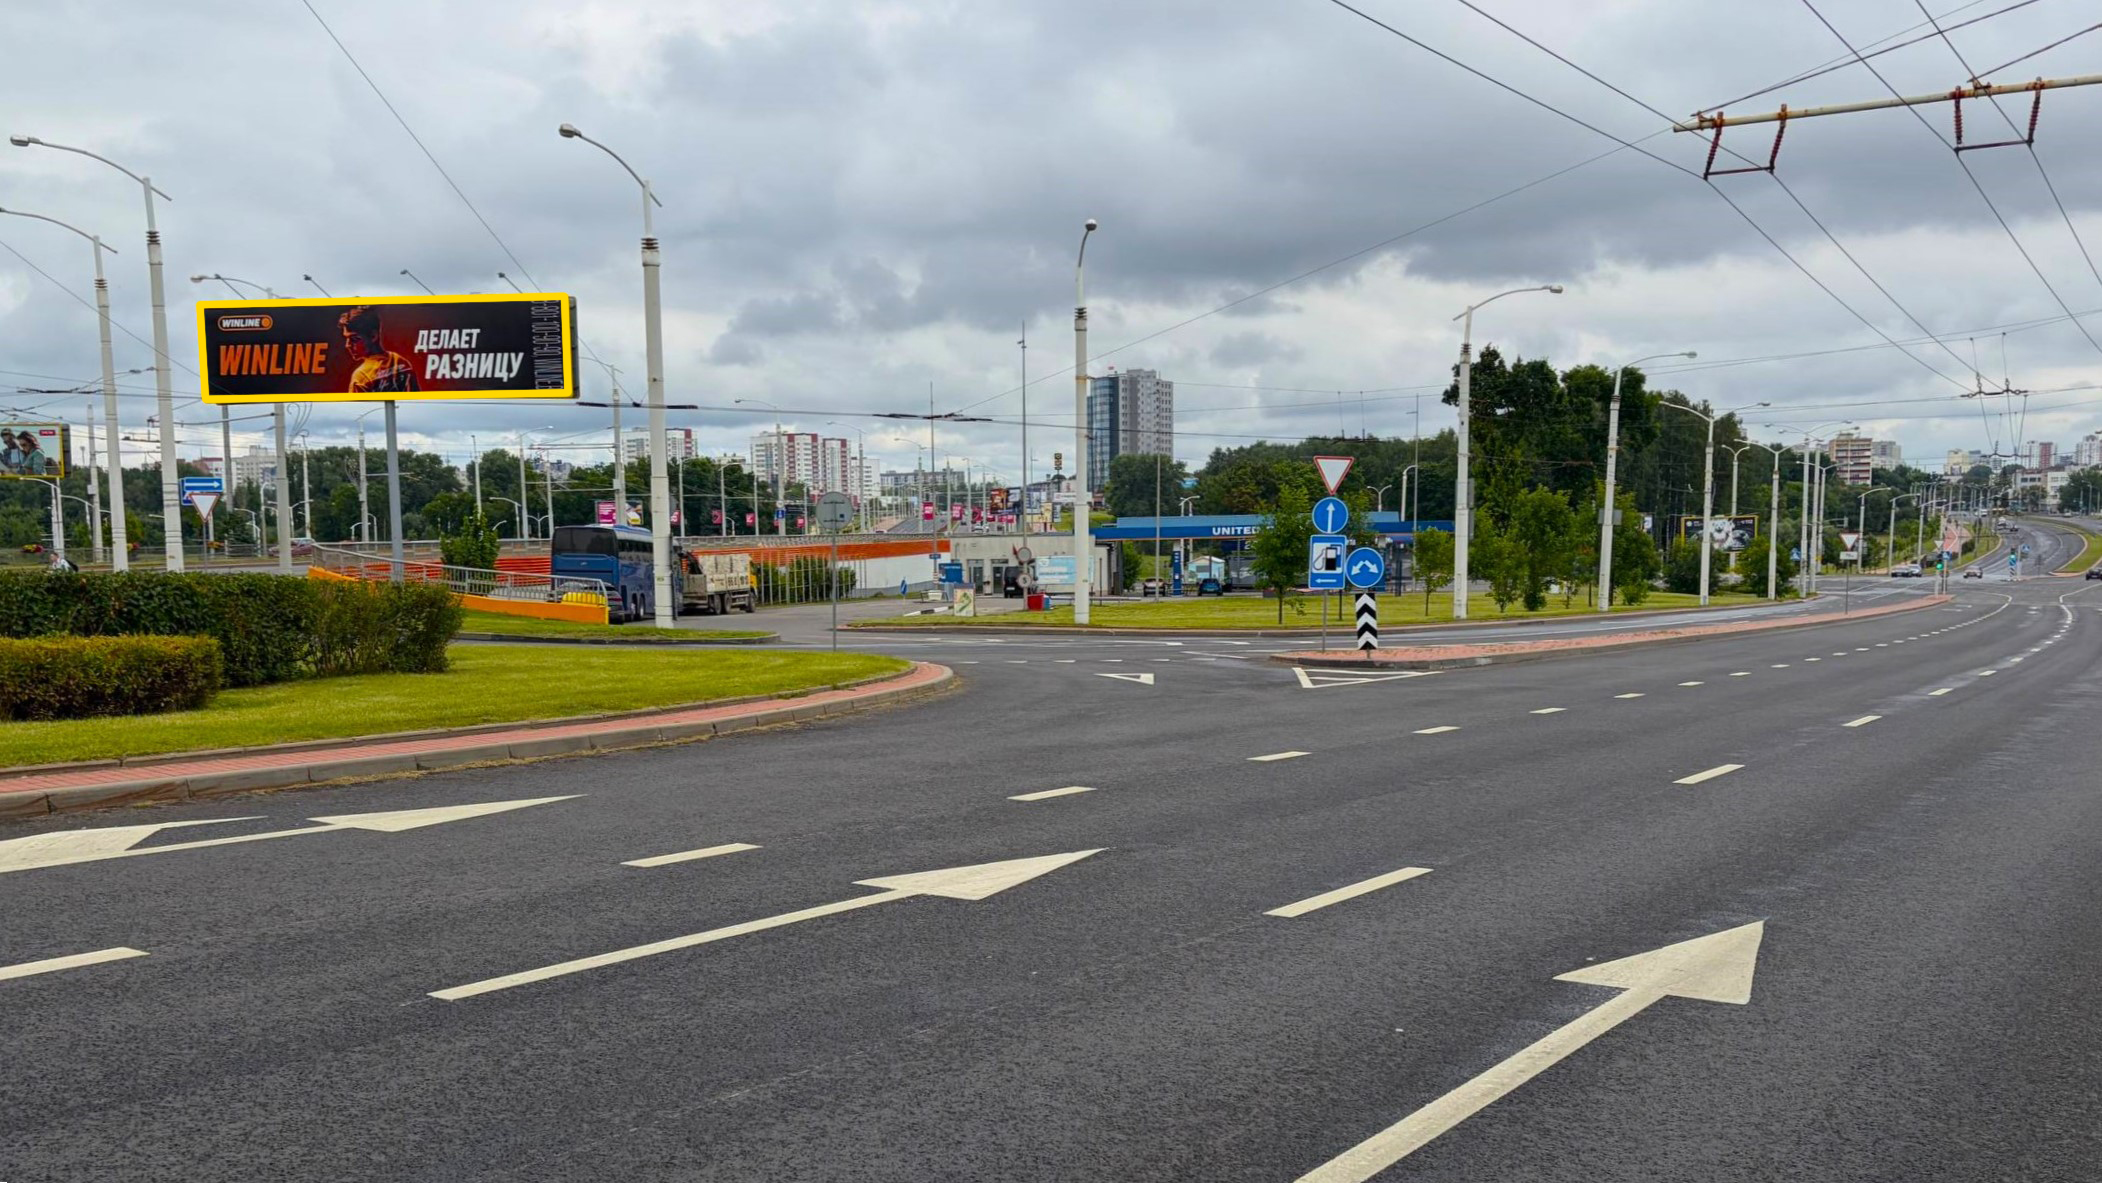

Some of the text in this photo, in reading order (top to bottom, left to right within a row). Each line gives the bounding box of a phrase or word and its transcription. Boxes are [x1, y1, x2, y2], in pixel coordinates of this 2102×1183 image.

[222, 318, 260, 328] WINLINE
[414, 329, 481, 353] ДЕЛАЕТ
[220, 343, 328, 376] WINLINE
[425, 352, 524, 382] РАЗНИЦУ
[1212, 526, 1261, 536] UNITED
